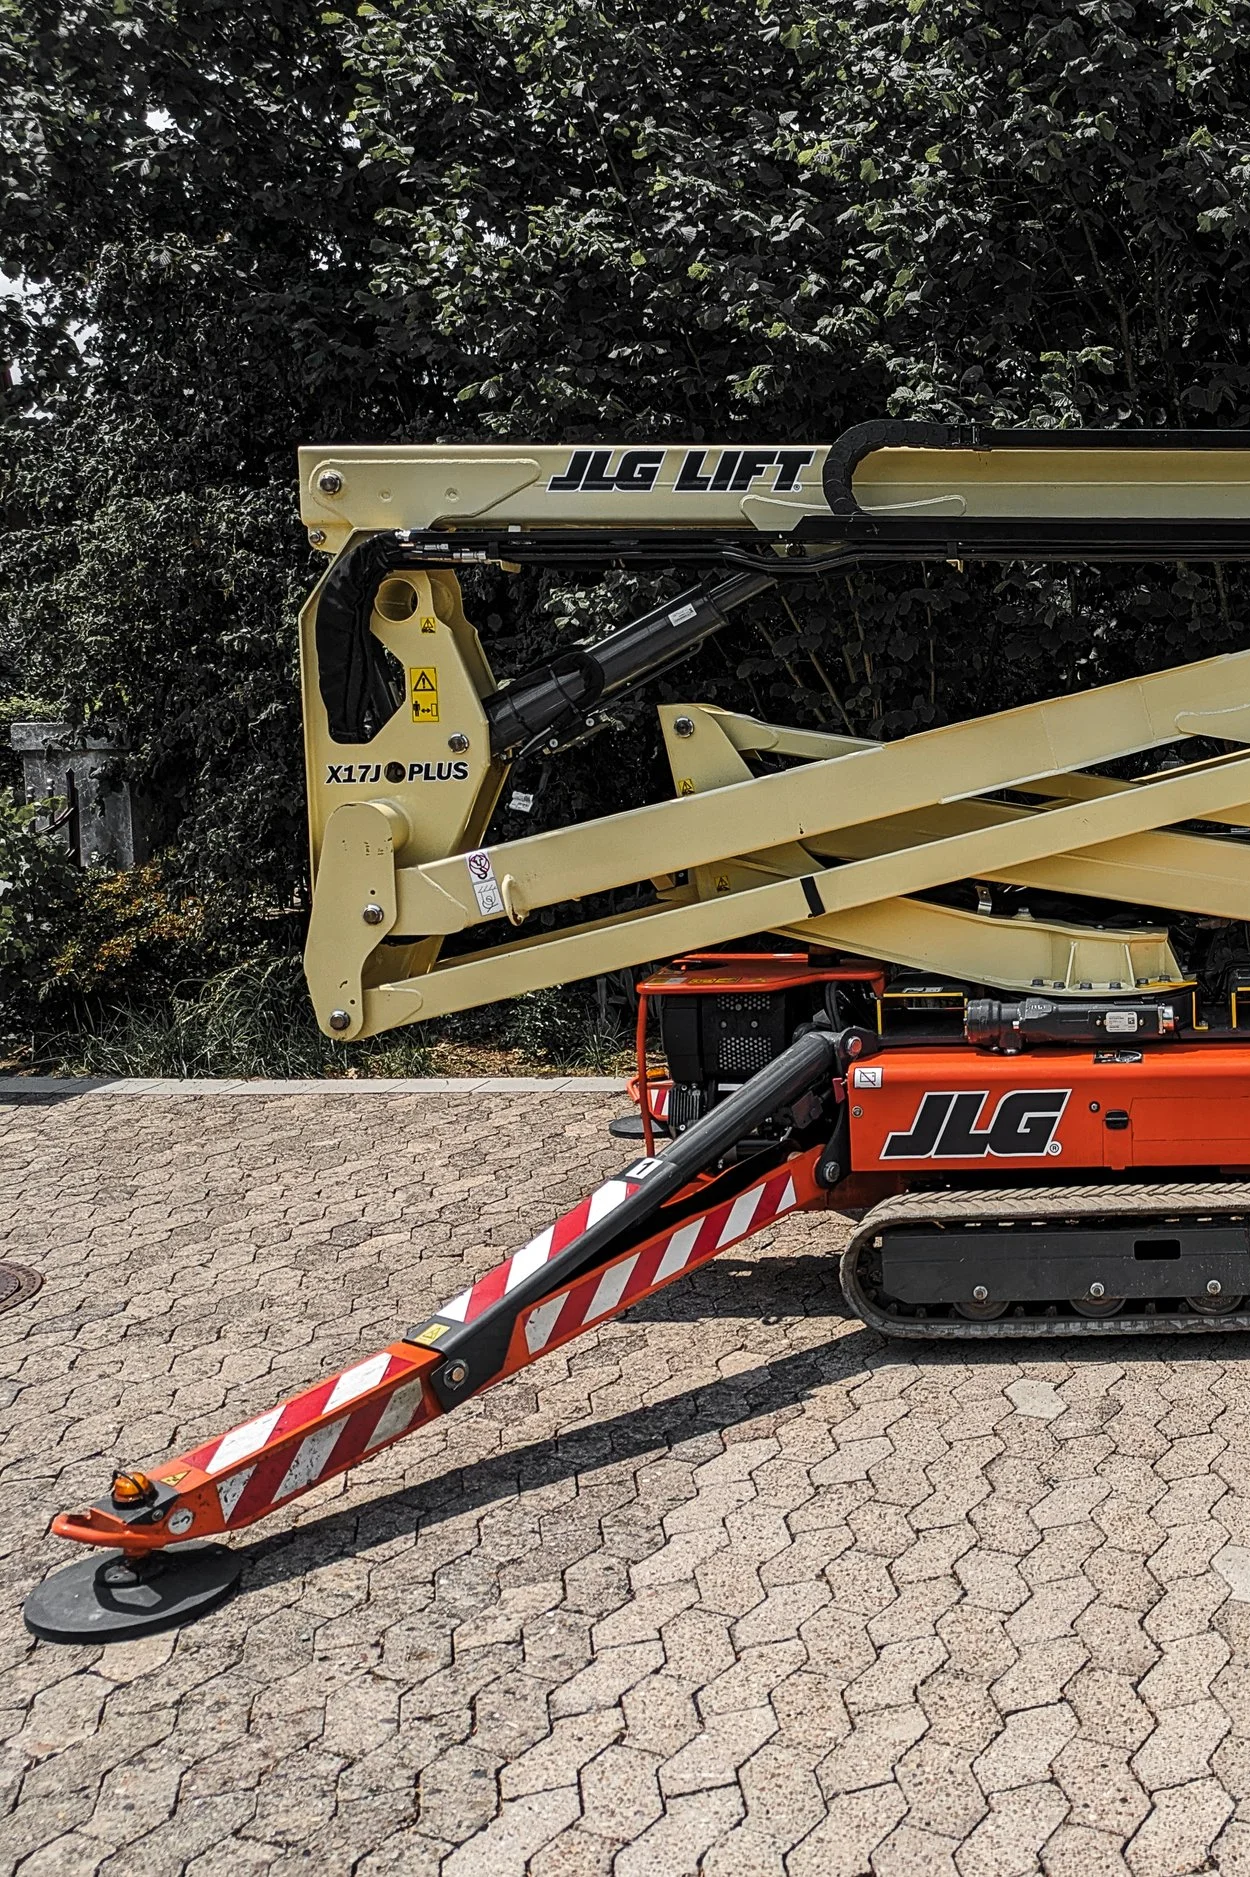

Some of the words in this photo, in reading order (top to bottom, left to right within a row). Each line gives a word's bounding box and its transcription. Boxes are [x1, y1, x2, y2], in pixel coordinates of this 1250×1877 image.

[546, 449, 667, 492] JLG
[325, 764, 382, 784] X17J
[407, 761, 469, 782] PLUS
[635, 1160, 655, 1176] 1
